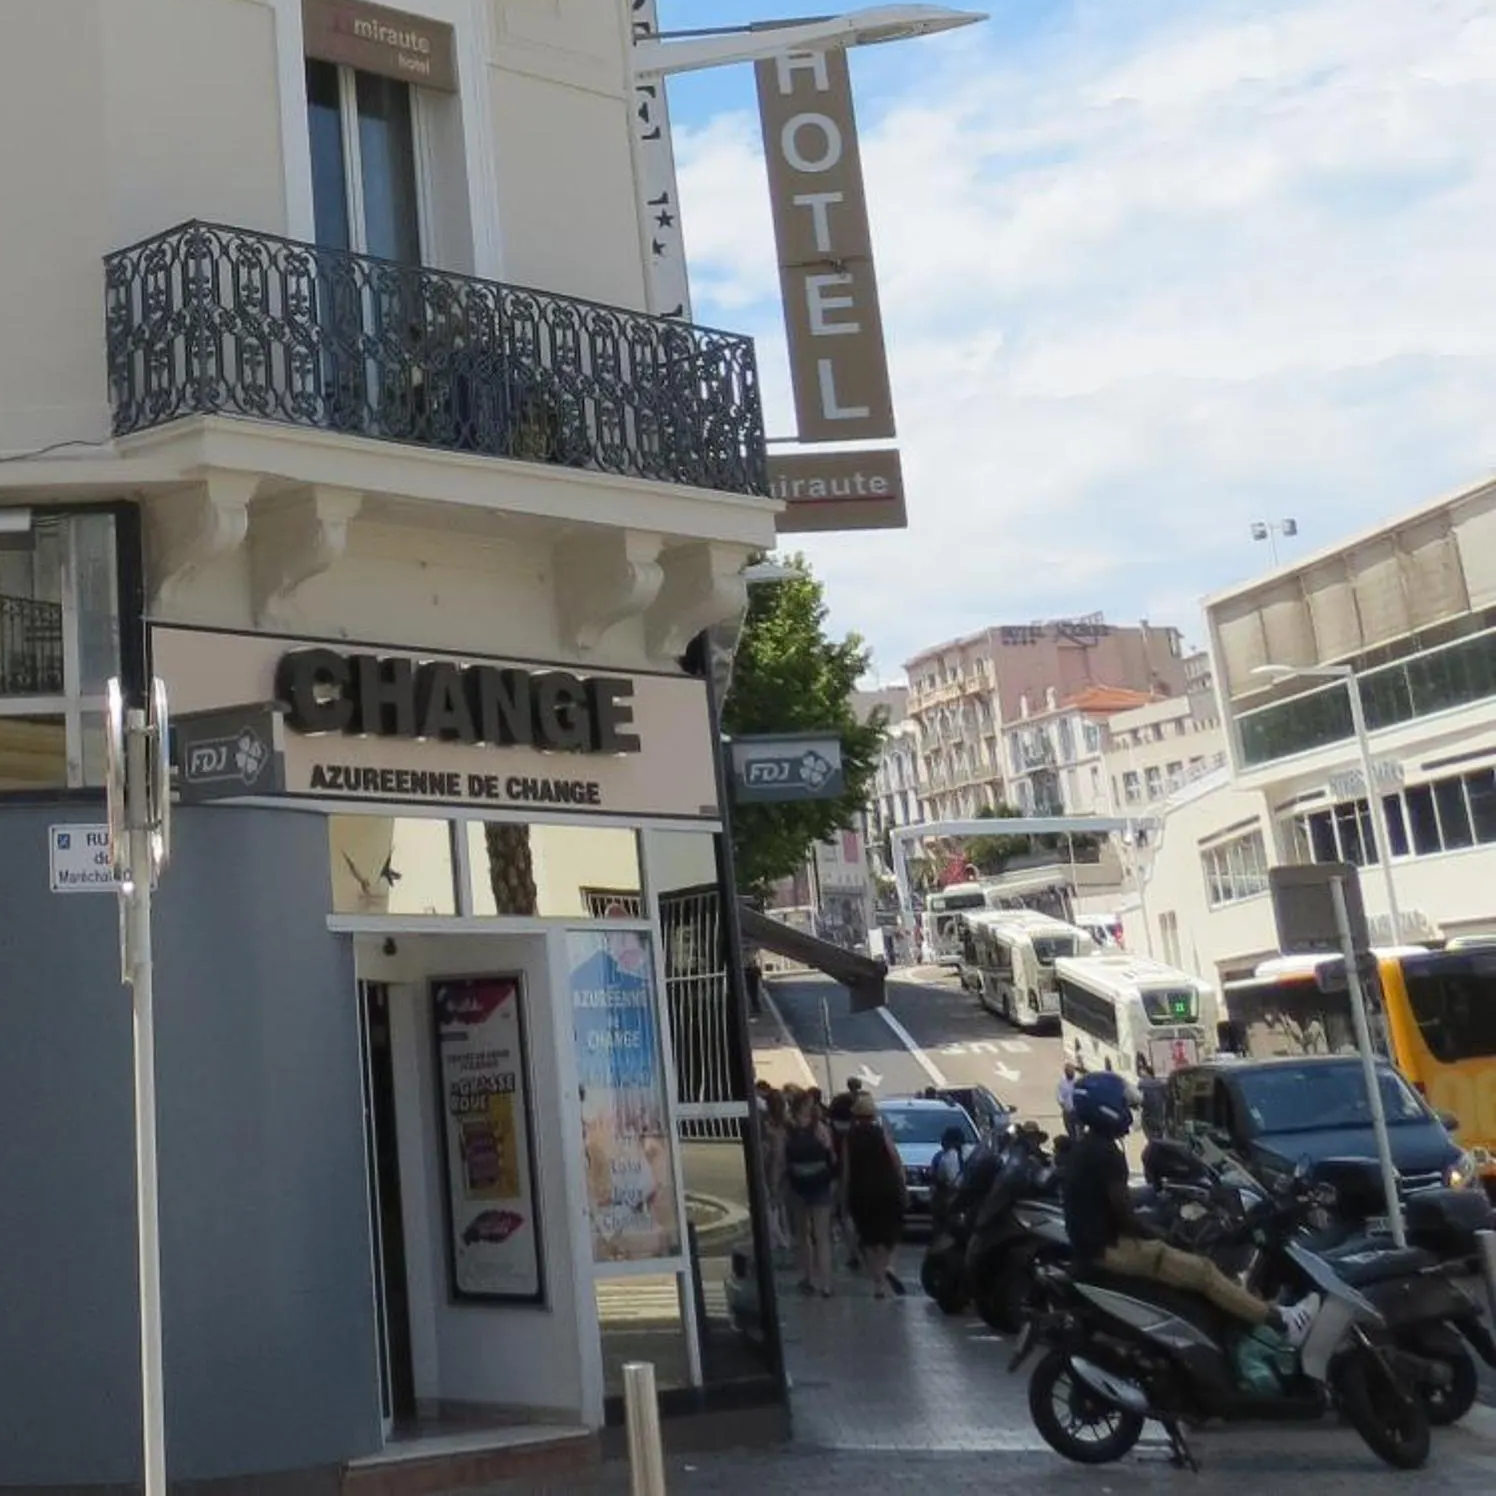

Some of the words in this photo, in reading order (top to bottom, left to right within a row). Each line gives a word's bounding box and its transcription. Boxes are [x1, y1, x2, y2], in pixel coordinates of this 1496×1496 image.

[770, 472, 890, 498] iraute
[275, 647, 641, 756] CHANGE
[190, 746, 228, 774] FDJ
[749, 762, 790, 781] FDJ
[310, 764, 461, 797] AZUREENNE
[468, 774, 500, 800] DE
[506, 776, 602, 805] CHANGE
[87, 832, 110, 846] RU
